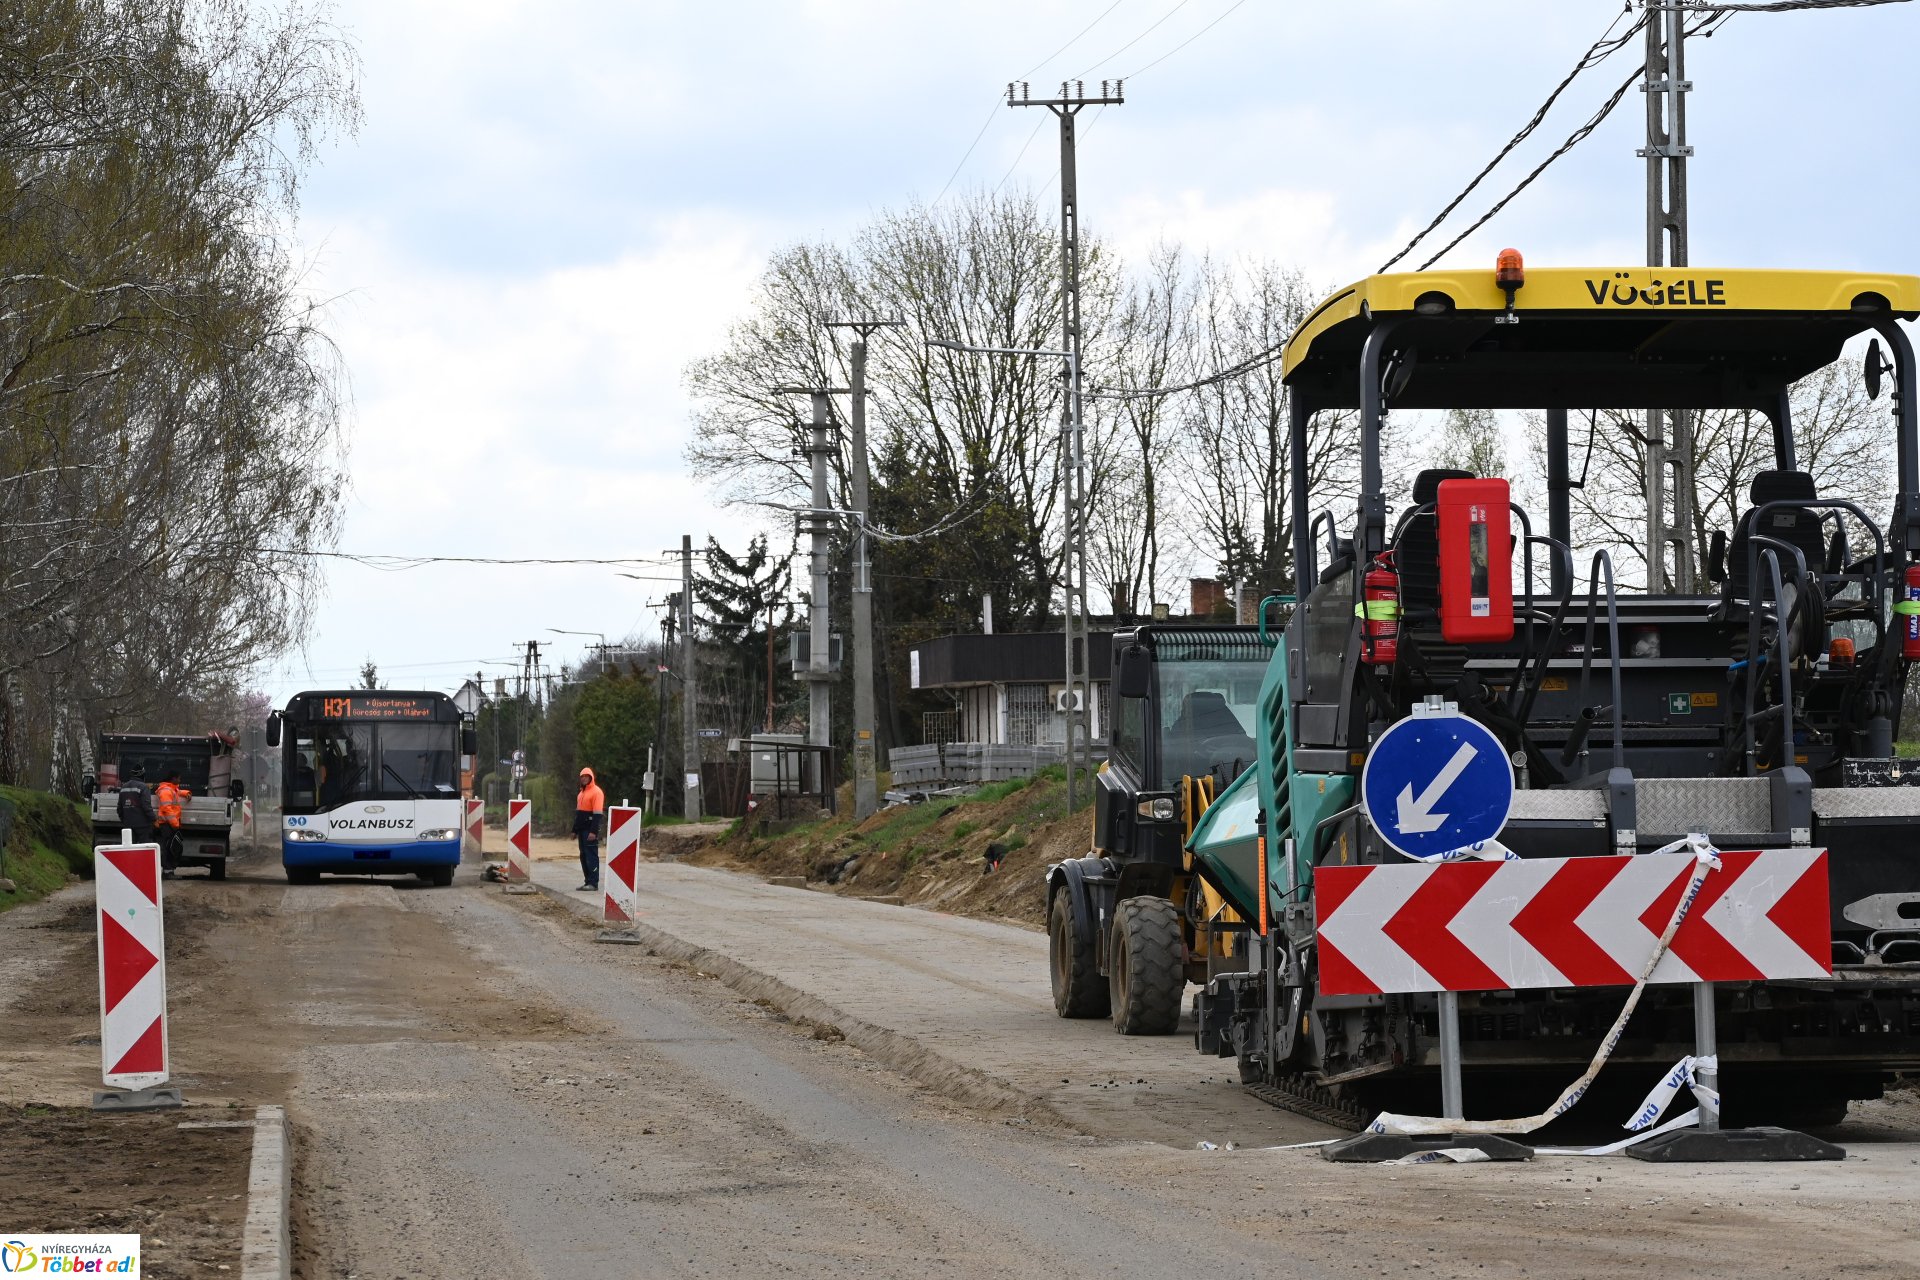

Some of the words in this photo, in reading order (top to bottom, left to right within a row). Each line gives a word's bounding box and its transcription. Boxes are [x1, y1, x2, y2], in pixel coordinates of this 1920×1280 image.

[1584, 272, 1726, 306] VÖGELE
[324, 698, 351, 717] H31
[329, 819, 415, 829] VOLÁNBUSZ
